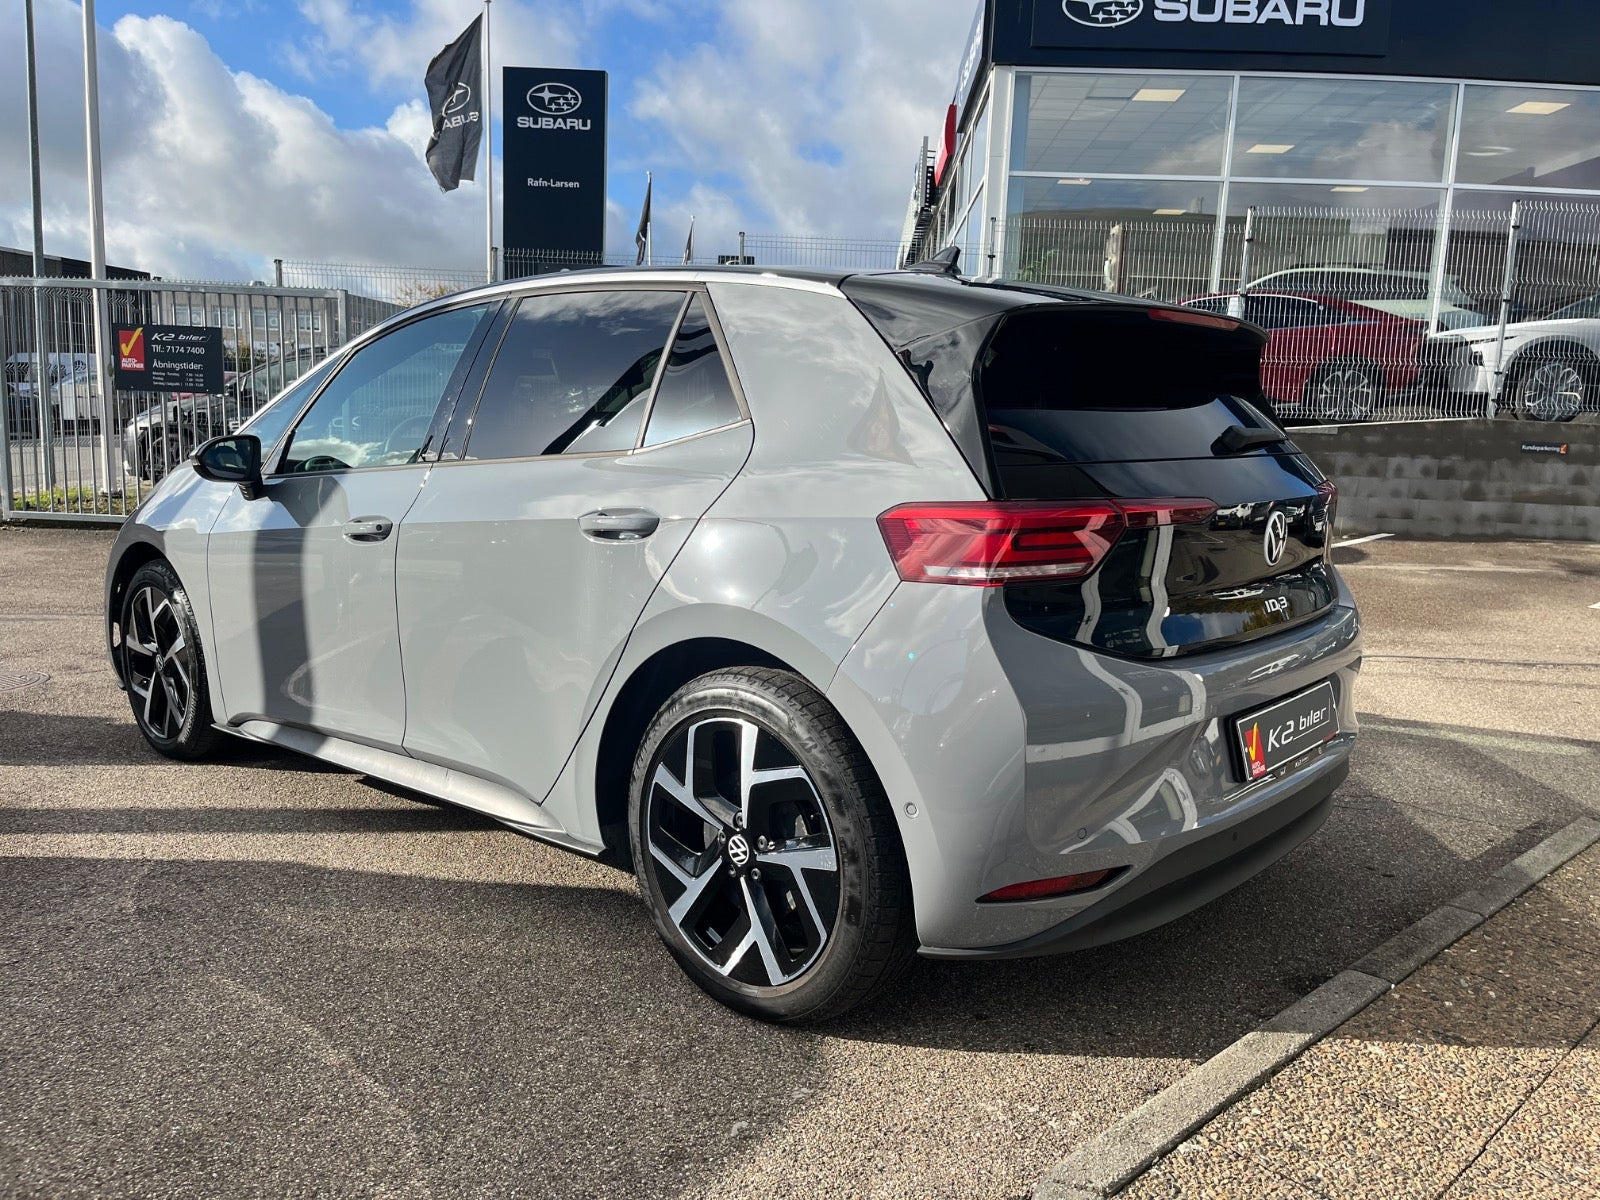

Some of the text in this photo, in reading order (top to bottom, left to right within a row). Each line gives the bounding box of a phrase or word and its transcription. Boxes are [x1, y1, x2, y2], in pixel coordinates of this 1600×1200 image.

[1154, 0, 1364, 27] SUBARU
[517, 116, 591, 130] SUBARU
[527, 177, 580, 188] Rafn-Larsen
[151, 333, 175, 341] K2
[151, 344, 205, 355] Tlf.: 7174 7400
[152, 359, 204, 371] Åbningstider:
[1267, 707, 1327, 752] K2 biler
